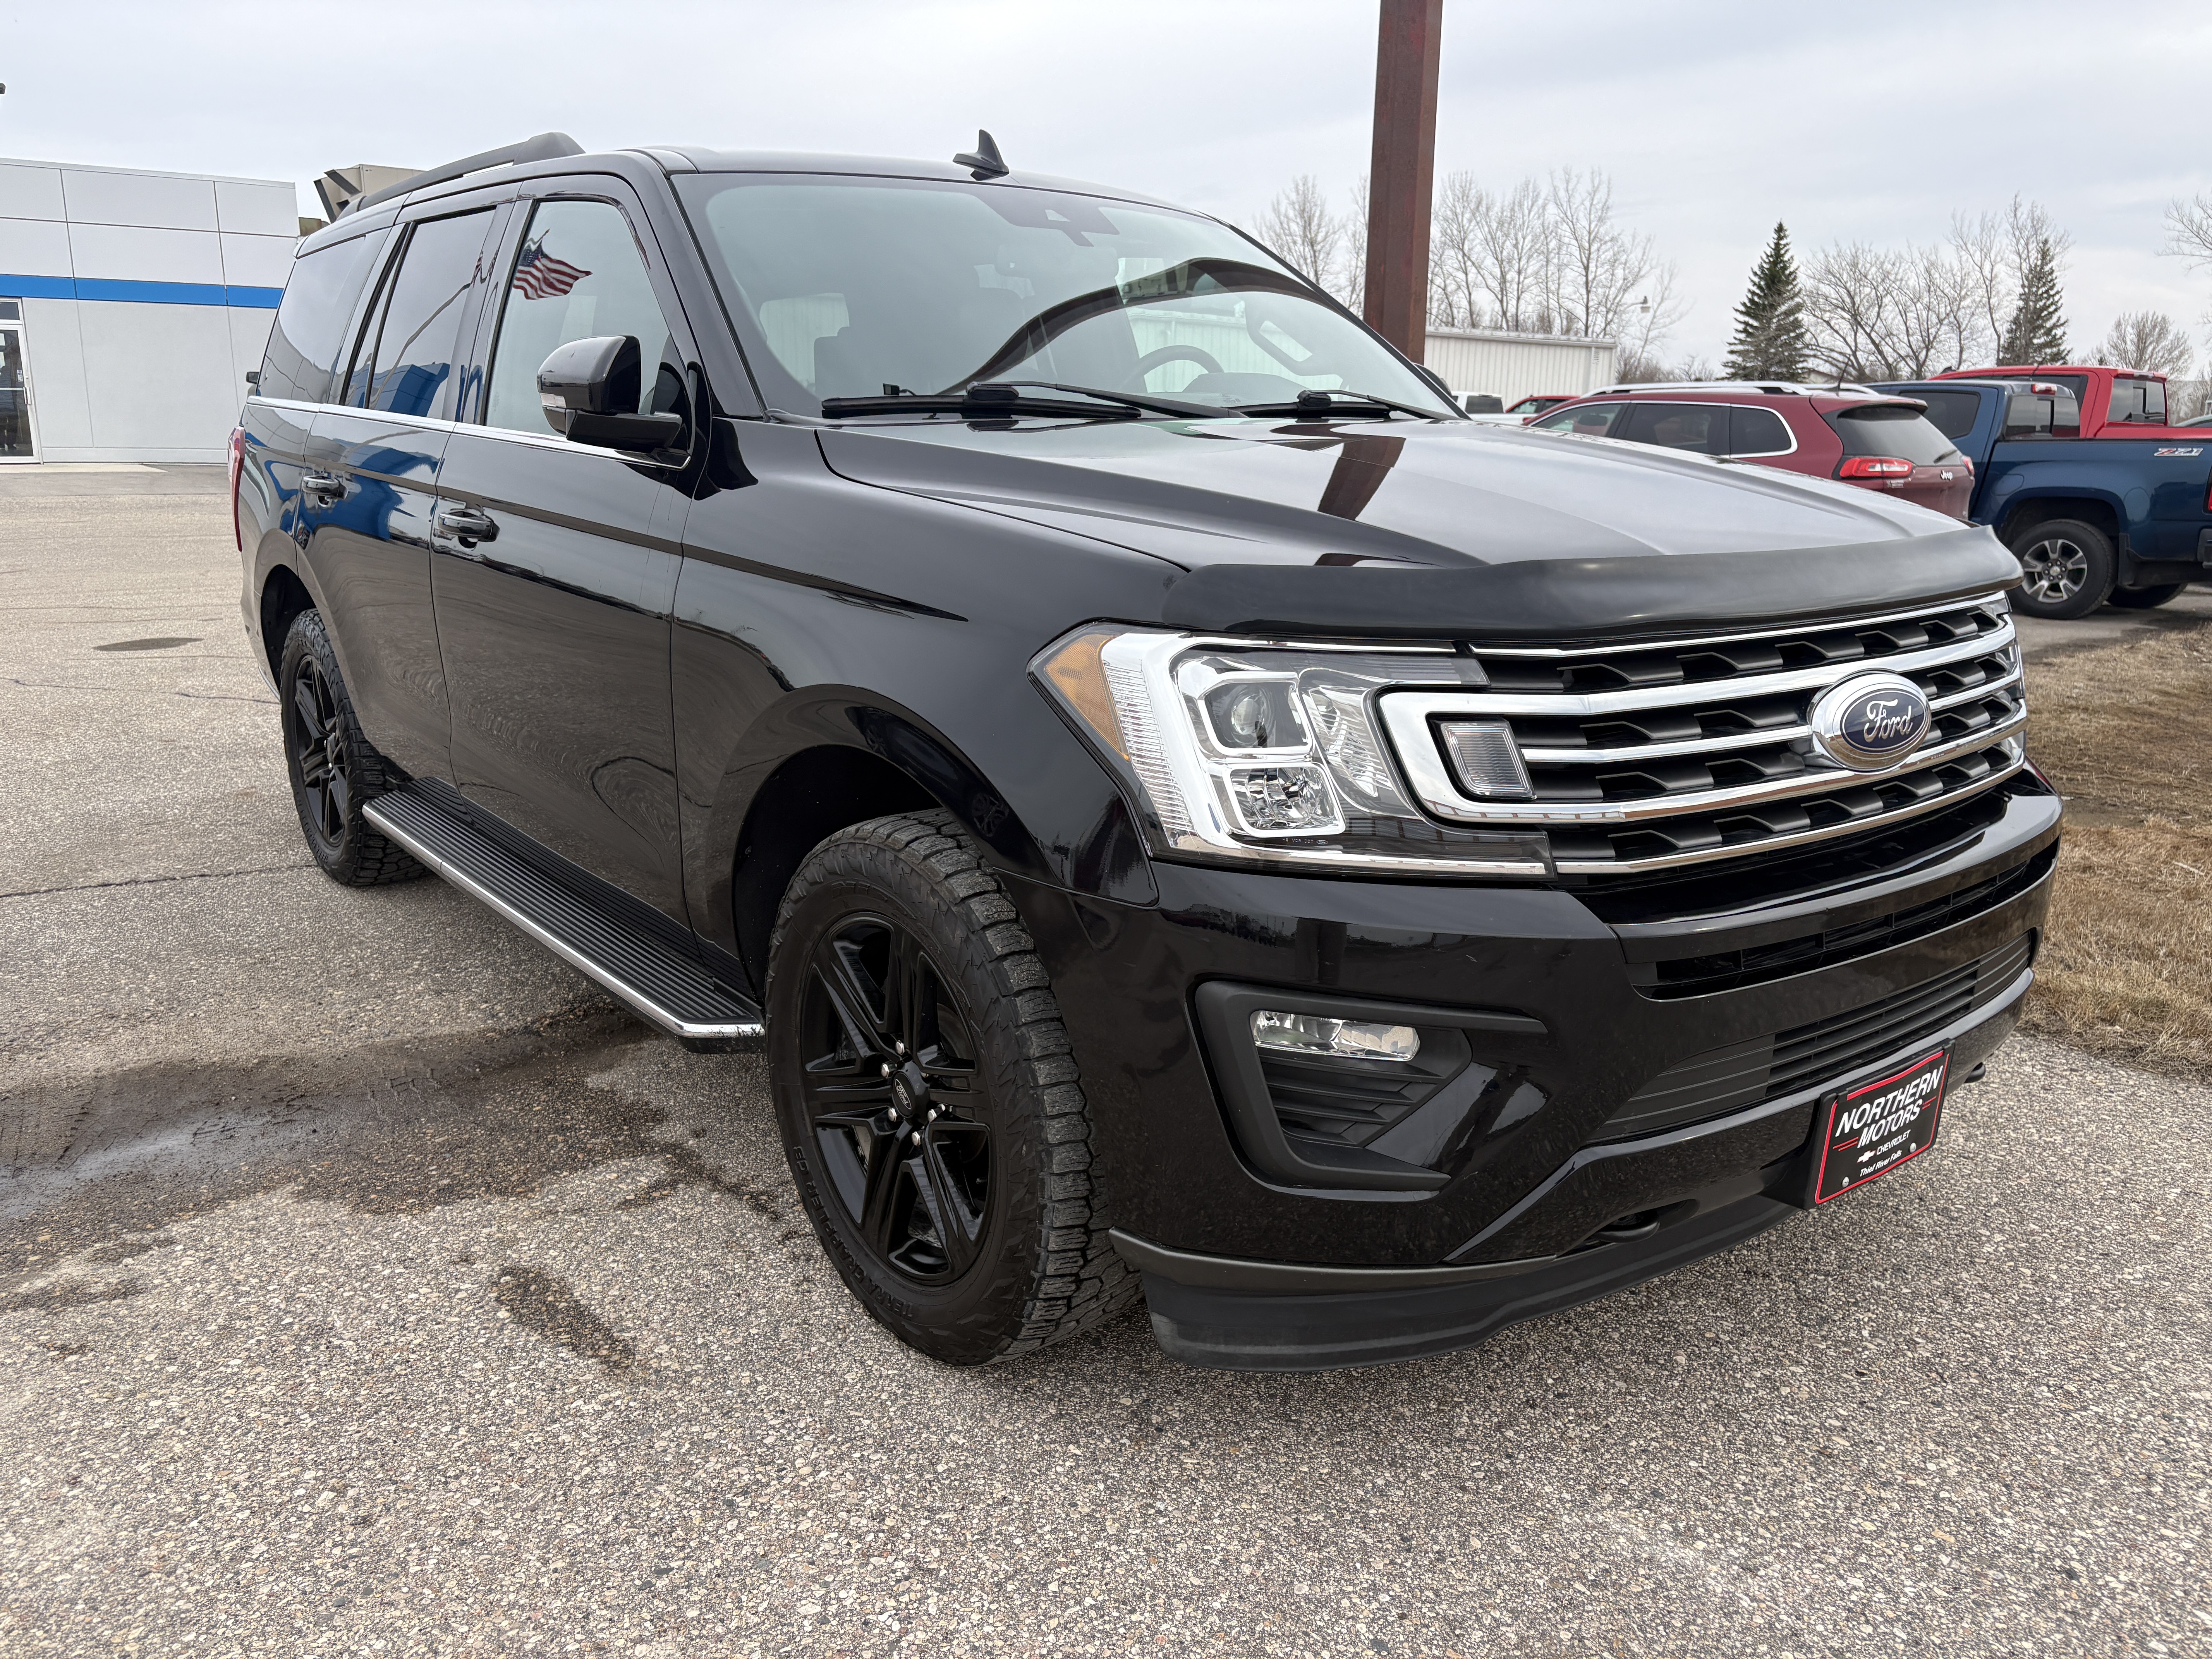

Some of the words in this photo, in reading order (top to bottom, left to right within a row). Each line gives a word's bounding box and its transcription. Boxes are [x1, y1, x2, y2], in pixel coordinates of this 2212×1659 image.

[2154, 448, 2203, 456] Z71
[1941, 470, 1953, 480] Jeep
[1863, 698, 1913, 743] Ford
[896, 1085, 909, 1105] Ford
[1835, 1065, 1943, 1137] NORTHERN
[1857, 1100, 1923, 1149] MOTORS
[1876, 1129, 1911, 1155] CHEVROLET
[1860, 1163, 1876, 1177] Thief
[1875, 1157, 1890, 1170] River
[1890, 1150, 1902, 1162] Falls
[805, 1180, 867, 1283] GRAPPLER
[868, 1276, 913, 1318] TERRA
